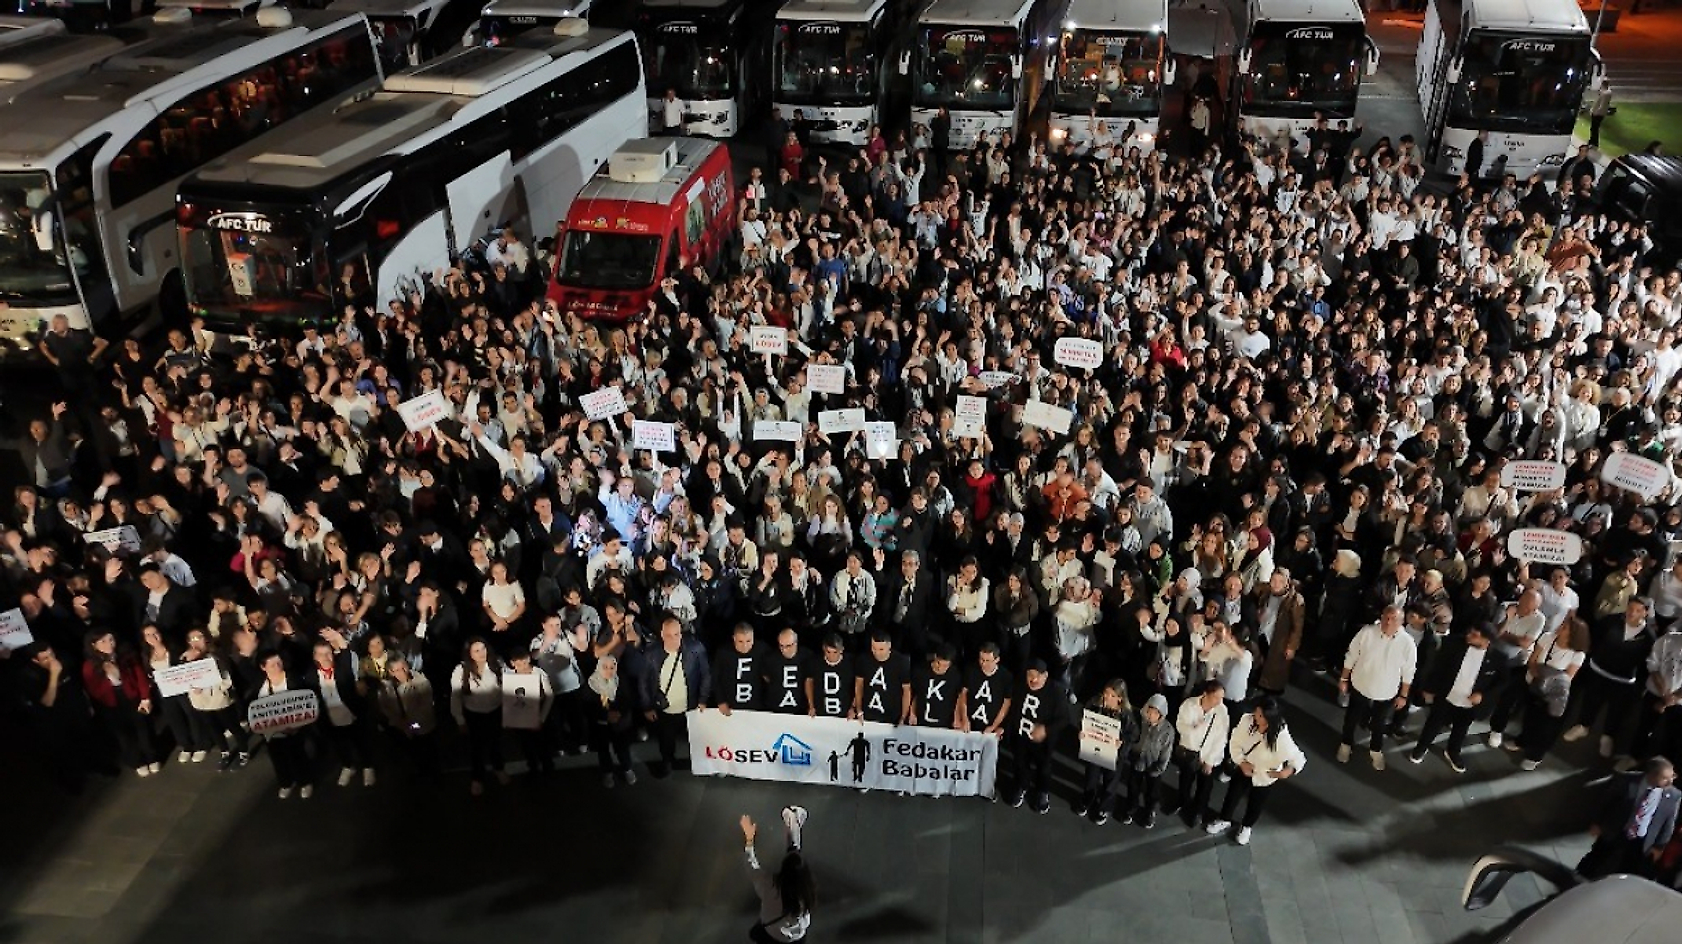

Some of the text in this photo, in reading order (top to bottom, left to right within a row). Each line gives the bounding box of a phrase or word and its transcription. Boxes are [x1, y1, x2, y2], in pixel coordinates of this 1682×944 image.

[217, 217, 272, 233] AFC TUR
[254, 709, 316, 730] ATAMIZA!
[705, 744, 778, 764] LÖSEV
[883, 738, 982, 762] Fedakar
[882, 759, 975, 782] Babalar
